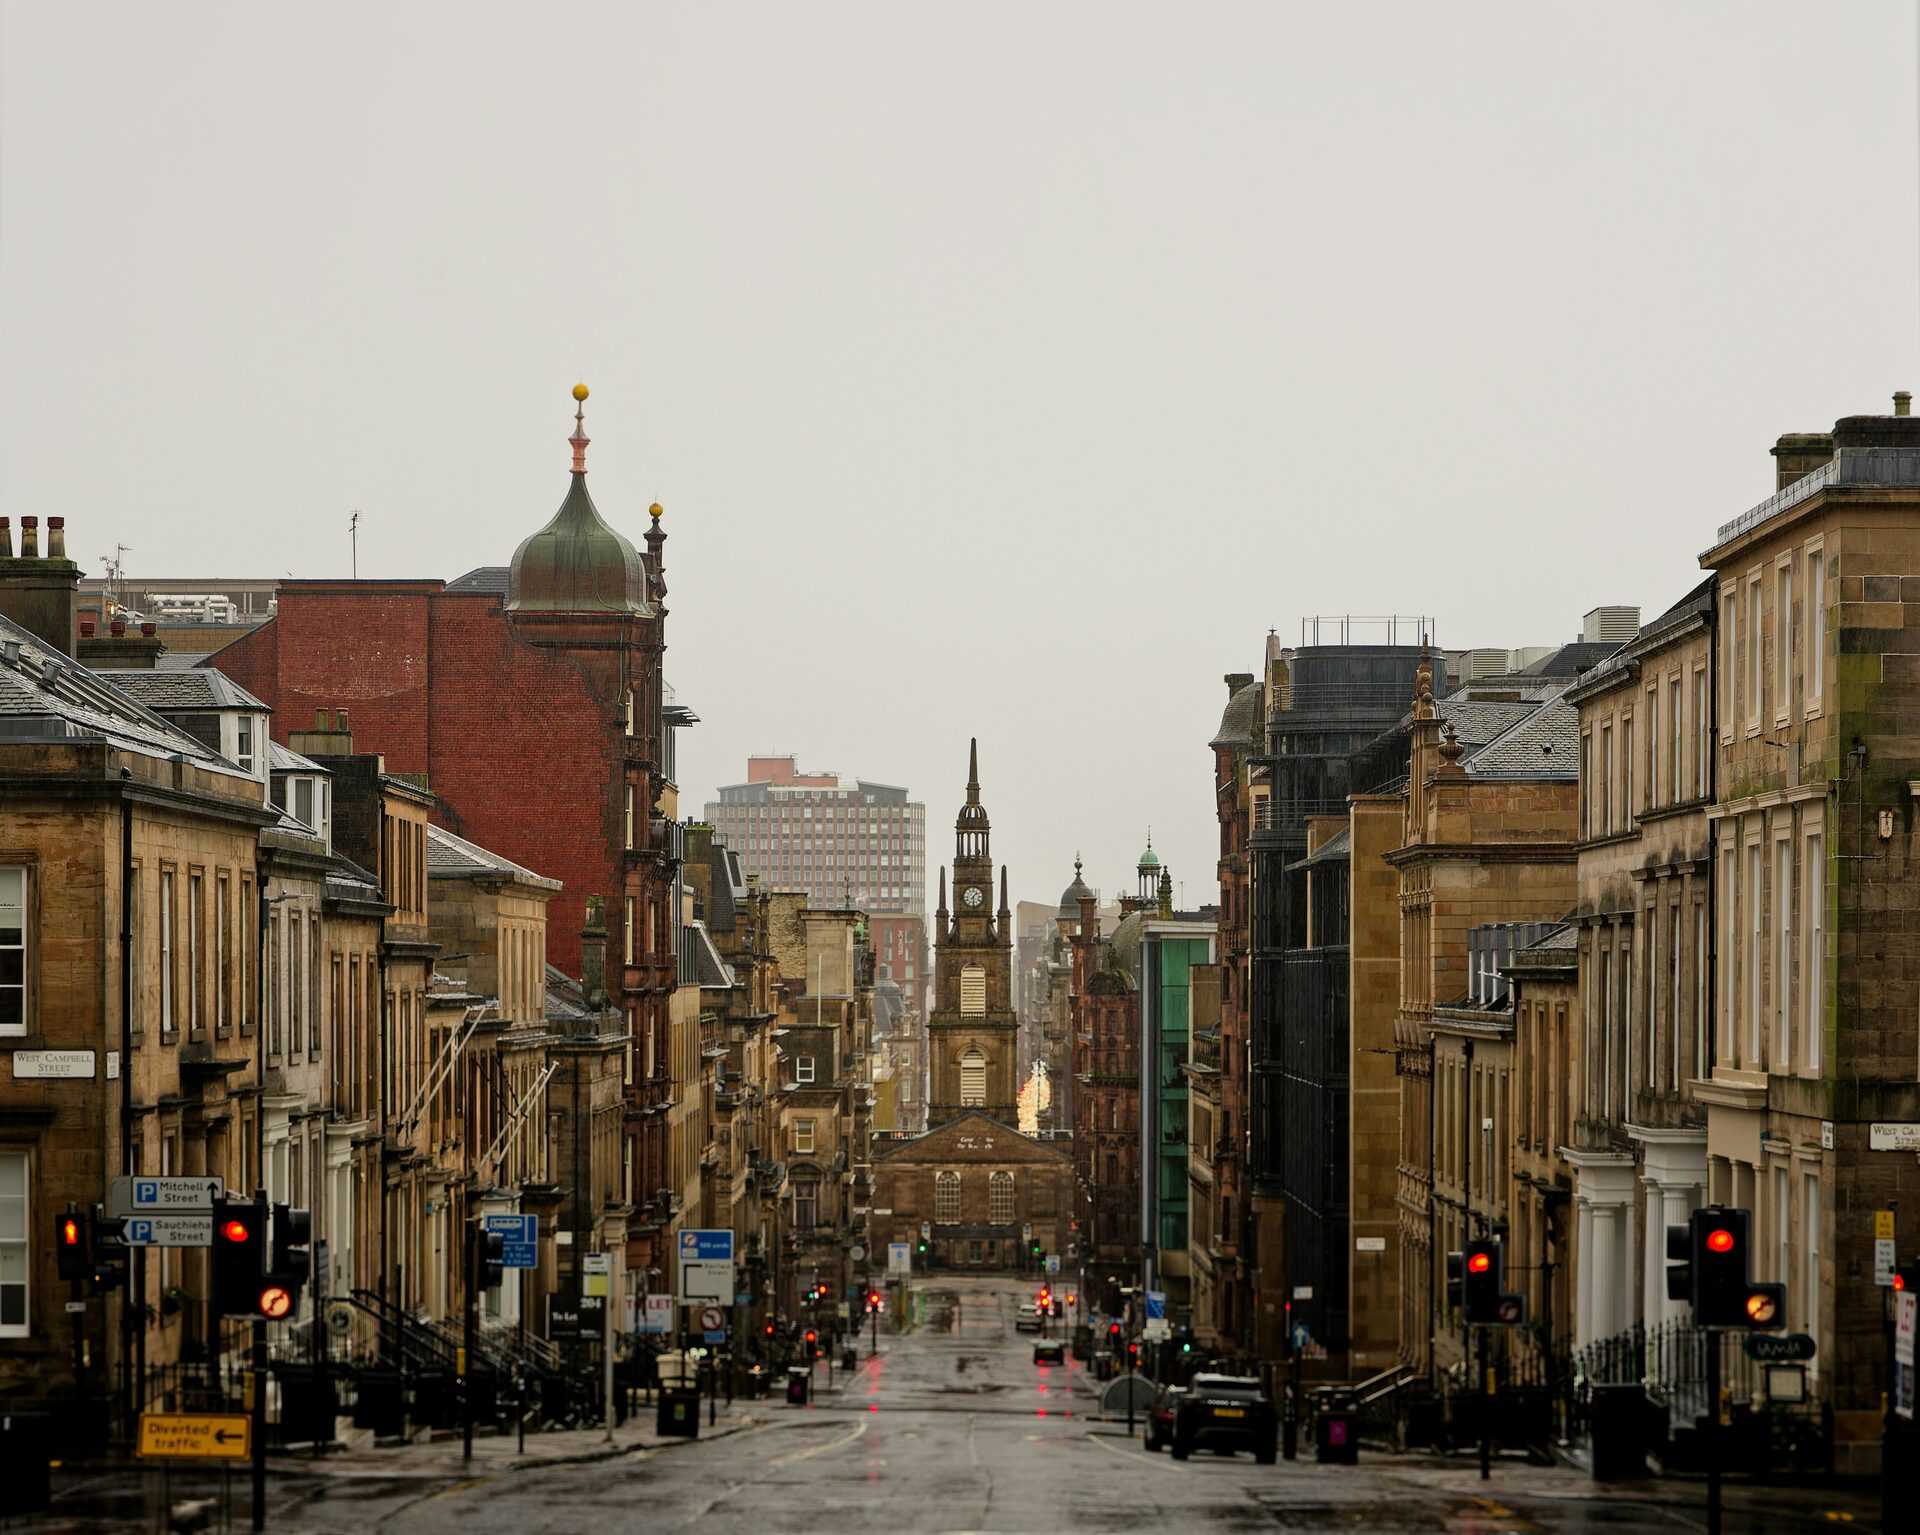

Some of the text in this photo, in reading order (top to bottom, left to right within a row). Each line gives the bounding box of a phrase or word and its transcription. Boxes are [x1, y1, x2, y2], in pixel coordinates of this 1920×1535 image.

[160, 1182, 204, 1191] Mitchell
[164, 1193, 199, 1202] Street
[170, 1232, 204, 1241] Street
[648, 1299, 671, 1310] LET
[149, 1423, 210, 1436] Diverted
[155, 1439, 203, 1449] traffic
